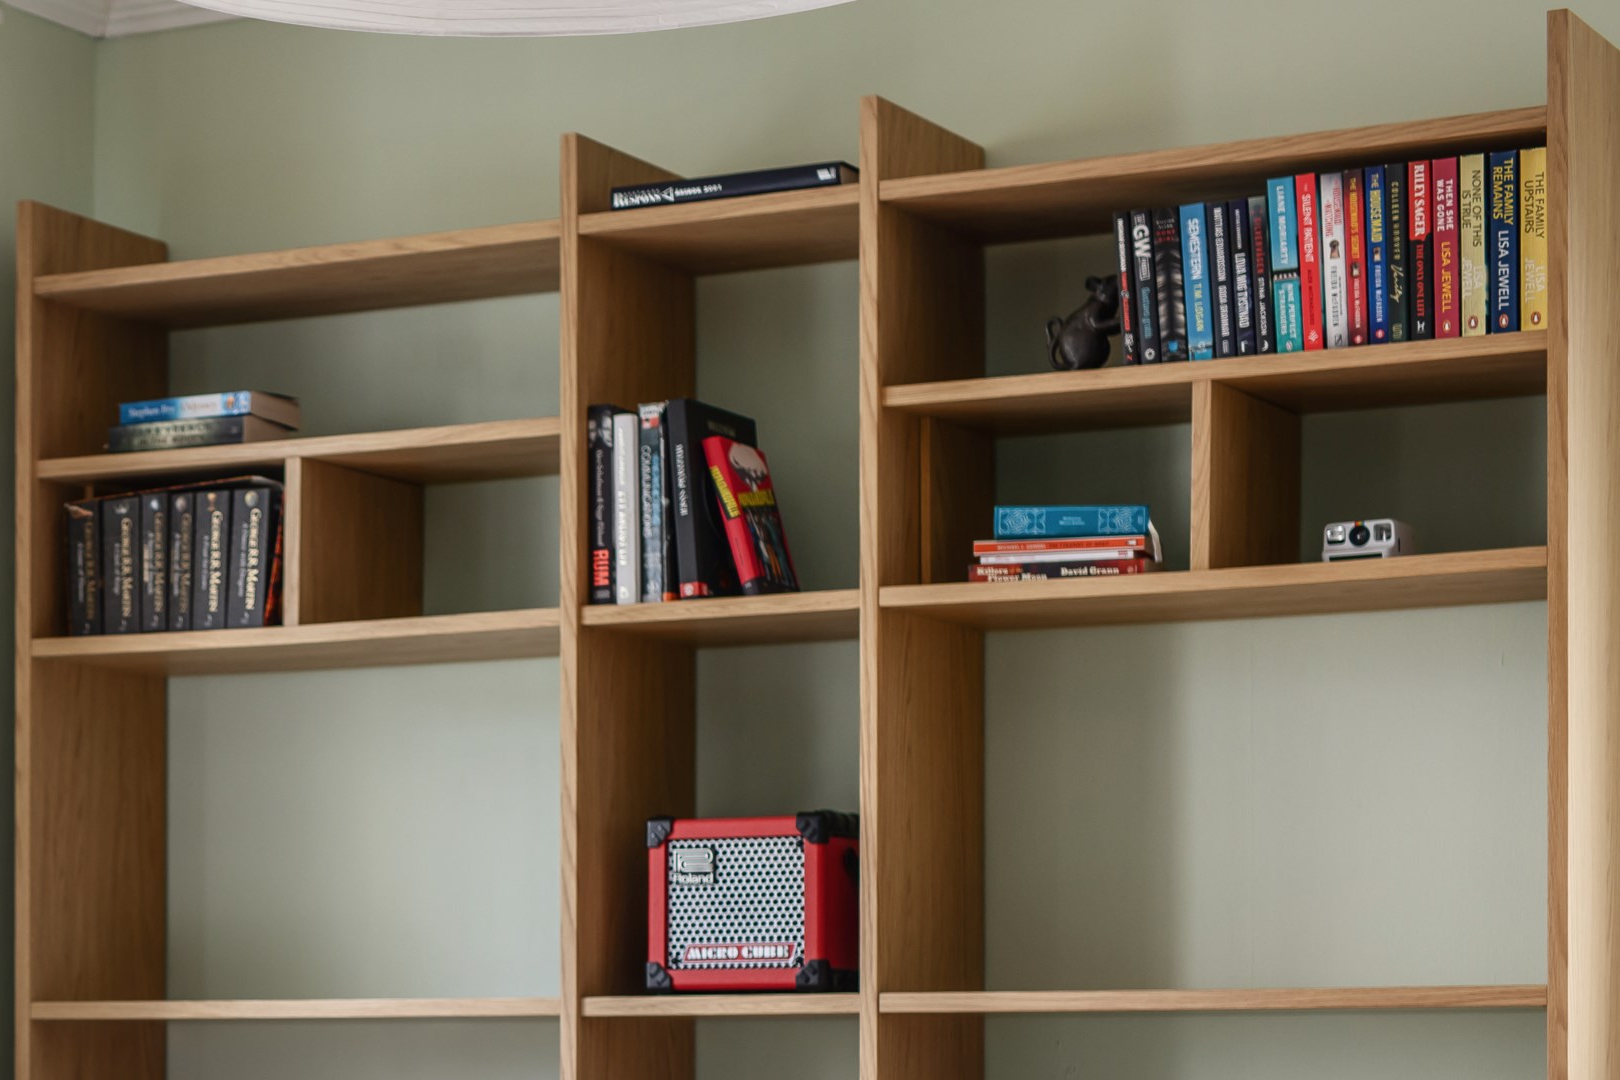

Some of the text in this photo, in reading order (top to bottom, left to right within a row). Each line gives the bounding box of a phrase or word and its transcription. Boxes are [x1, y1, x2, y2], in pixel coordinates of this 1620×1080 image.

[1370, 173, 1382, 243] THE HOUSEMAID
[1391, 181, 1399, 221] COLLEEN
[1414, 164, 1425, 237] RILEY SAGER
[1445, 179, 1454, 230] THEN SHE
[1462, 190, 1471, 229] IS TRUE
[1472, 170, 1482, 247] NONE OF THIS
[1493, 166, 1503, 219] REMAINS
[1503, 158, 1514, 225] THE FAMILY
[1524, 180, 1534, 233] UPSTAIRS
[1535, 172, 1545, 239] THE FAMILY
[1133, 224, 1151, 258] GW
[1214, 207, 1224, 237] MATTIAS
[1276, 186, 1288, 264] LIANE MORIARTY
[1302, 194, 1314, 262] SILENT PATIENT
[1188, 218, 1203, 280] SEMESTERN
[1236, 274, 1248, 291] MIG
[1390, 264, 1403, 303] Verity
[1416, 244, 1425, 317] THE ONLY ONE LEFT
[1441, 242, 1451, 312] LISA JEWELL
[1463, 257, 1473, 299] JEWELL
[1473, 265, 1483, 288] LISA
[1498, 230, 1509, 310] LISA JEWELL
[1525, 257, 1535, 303] JEWELL
[1536, 266, 1546, 292] LISA
[1194, 302, 1204, 331] LOGAN
[1238, 292, 1250, 328] TYSTNAD
[1259, 301, 1267, 336] JACKSON
[1279, 289, 1287, 335] STRANGERS
[1287, 283, 1296, 338] NINE PERFECT
[121, 517, 132, 555] GEORGE
[211, 510, 223, 550] GEORGE
[249, 508, 262, 547] GEORGE
[593, 549, 610, 586] RUM
[977, 567, 1008, 576] Killers
[988, 573, 1047, 582] Flower Moon
[1060, 566, 1119, 576] David Grann
[122, 577, 132, 617] MARTIN
[209, 571, 221, 612] MARTIN
[245, 569, 259, 610] MARTIN
[673, 873, 714, 884] Roland
[687, 945, 789, 960] MICRO CUBE
